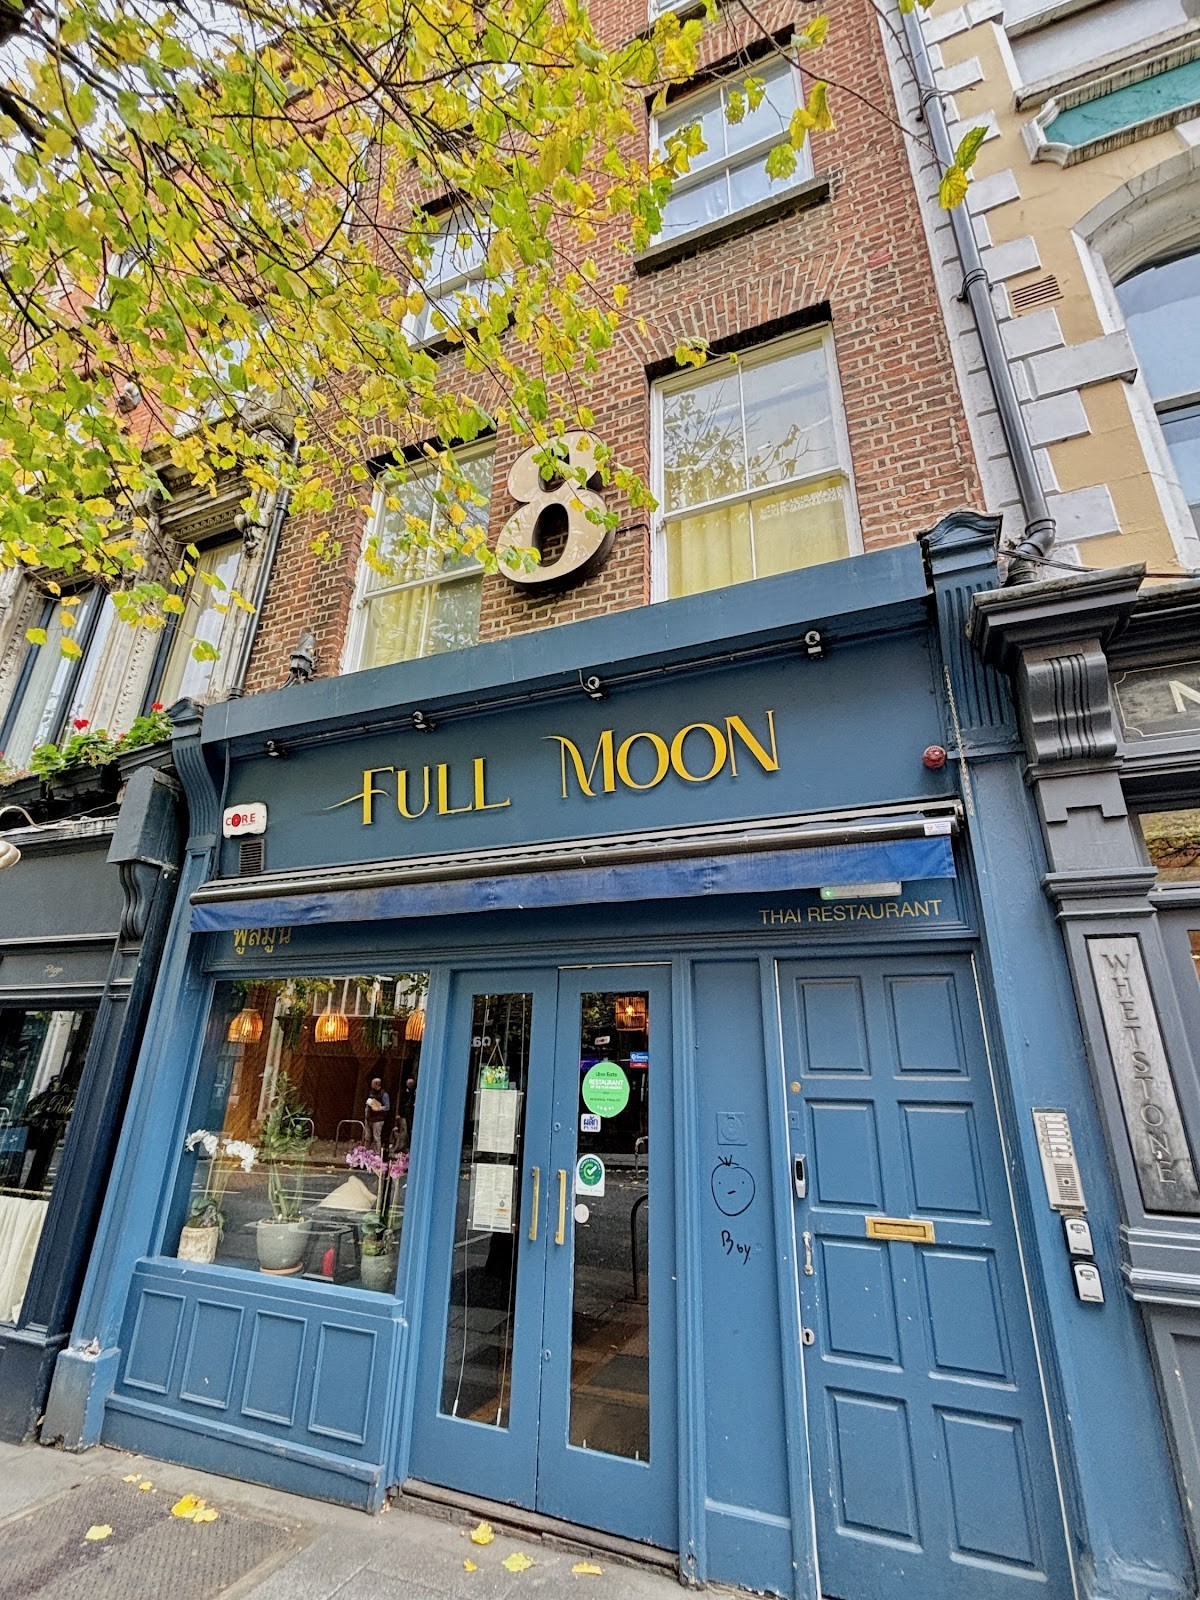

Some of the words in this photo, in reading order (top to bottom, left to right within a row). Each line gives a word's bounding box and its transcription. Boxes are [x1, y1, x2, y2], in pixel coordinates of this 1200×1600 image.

[496, 430, 610, 586] 8
[225, 813, 256, 828] CORE
[322, 757, 511, 825] FULL
[540, 709, 780, 798] MOON
[759, 908, 801, 925] THAI
[807, 900, 942, 923] RESTAURANT
[1101, 954, 1176, 1184] WHETSTONE
